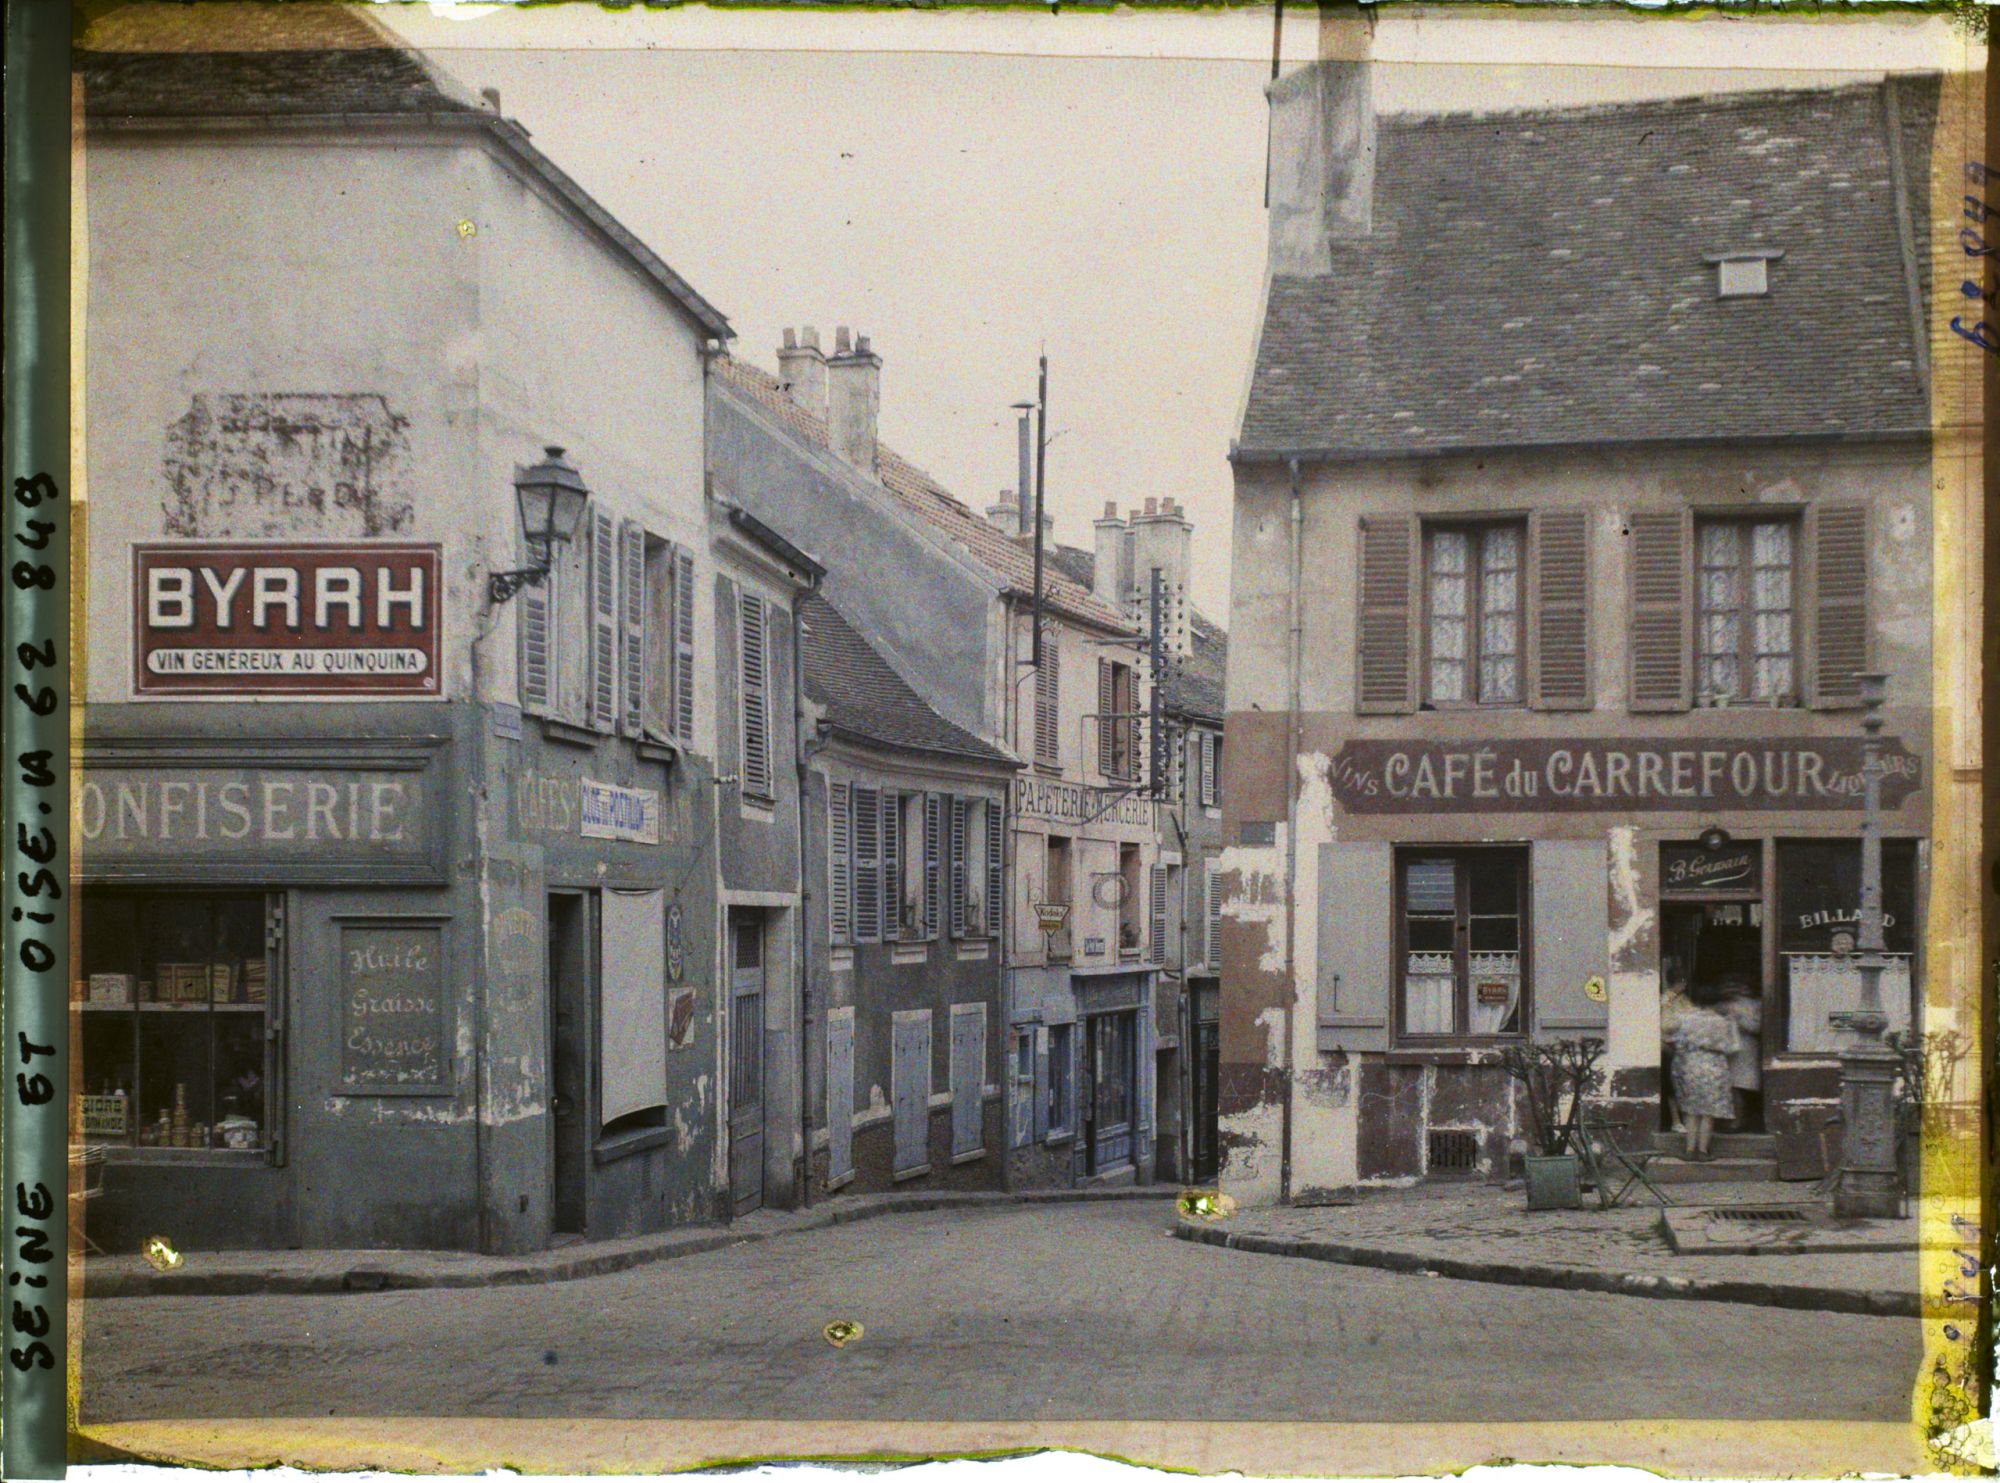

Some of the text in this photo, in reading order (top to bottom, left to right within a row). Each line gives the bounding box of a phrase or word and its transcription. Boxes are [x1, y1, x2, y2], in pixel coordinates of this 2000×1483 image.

[12, 472, 59, 590] 849
[148, 567, 424, 630] BYRRH
[15, 638, 58, 716] 62
[156, 652, 185, 670] VIN
[292, 652, 315, 670] AU
[323, 652, 418, 671] QUINQUINA
[1330, 756, 1379, 796] VINS
[1384, 746, 1500, 798] CAFÉ
[1504, 758, 1539, 798] du
[1546, 750, 1830, 798] CARREFOUR
[1799, 908, 1897, 929] BILLAD
[350, 944, 428, 974] Huile
[17, 1031, 56, 1106] ET
